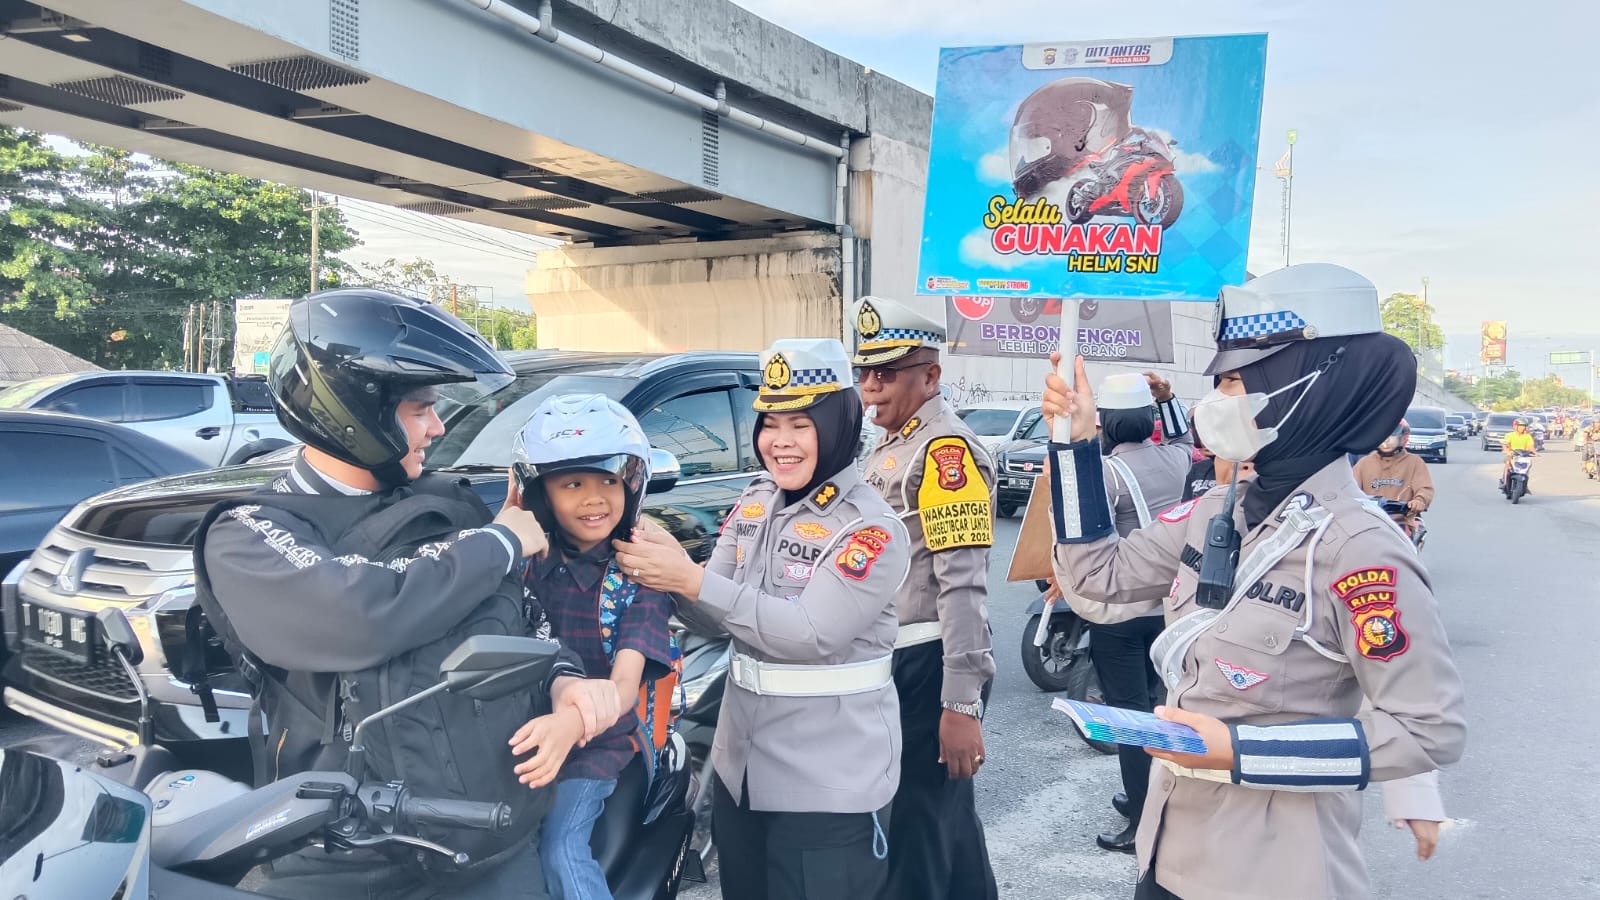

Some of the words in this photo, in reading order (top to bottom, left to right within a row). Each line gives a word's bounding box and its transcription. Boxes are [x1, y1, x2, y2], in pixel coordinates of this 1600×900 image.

[1085, 44, 1151, 57] DITLANTAS
[984, 196, 1061, 228] Selalu
[992, 223, 1162, 256] GUNAKAN
[1068, 255, 1120, 273] HELM
[1125, 255, 1157, 273] SNI
[981, 323, 1141, 345] BERBONENGAN
[998, 340, 1037, 353] LEBIH
[1079, 344, 1127, 357] ORANG
[922, 502, 988, 524] WAKASATGAS
[929, 535, 948, 549] OMP
[952, 532, 967, 544] LK
[1337, 570, 1390, 594] POLDA
[1246, 580, 1306, 613] OLRI
[1350, 592, 1390, 607] RIAU
